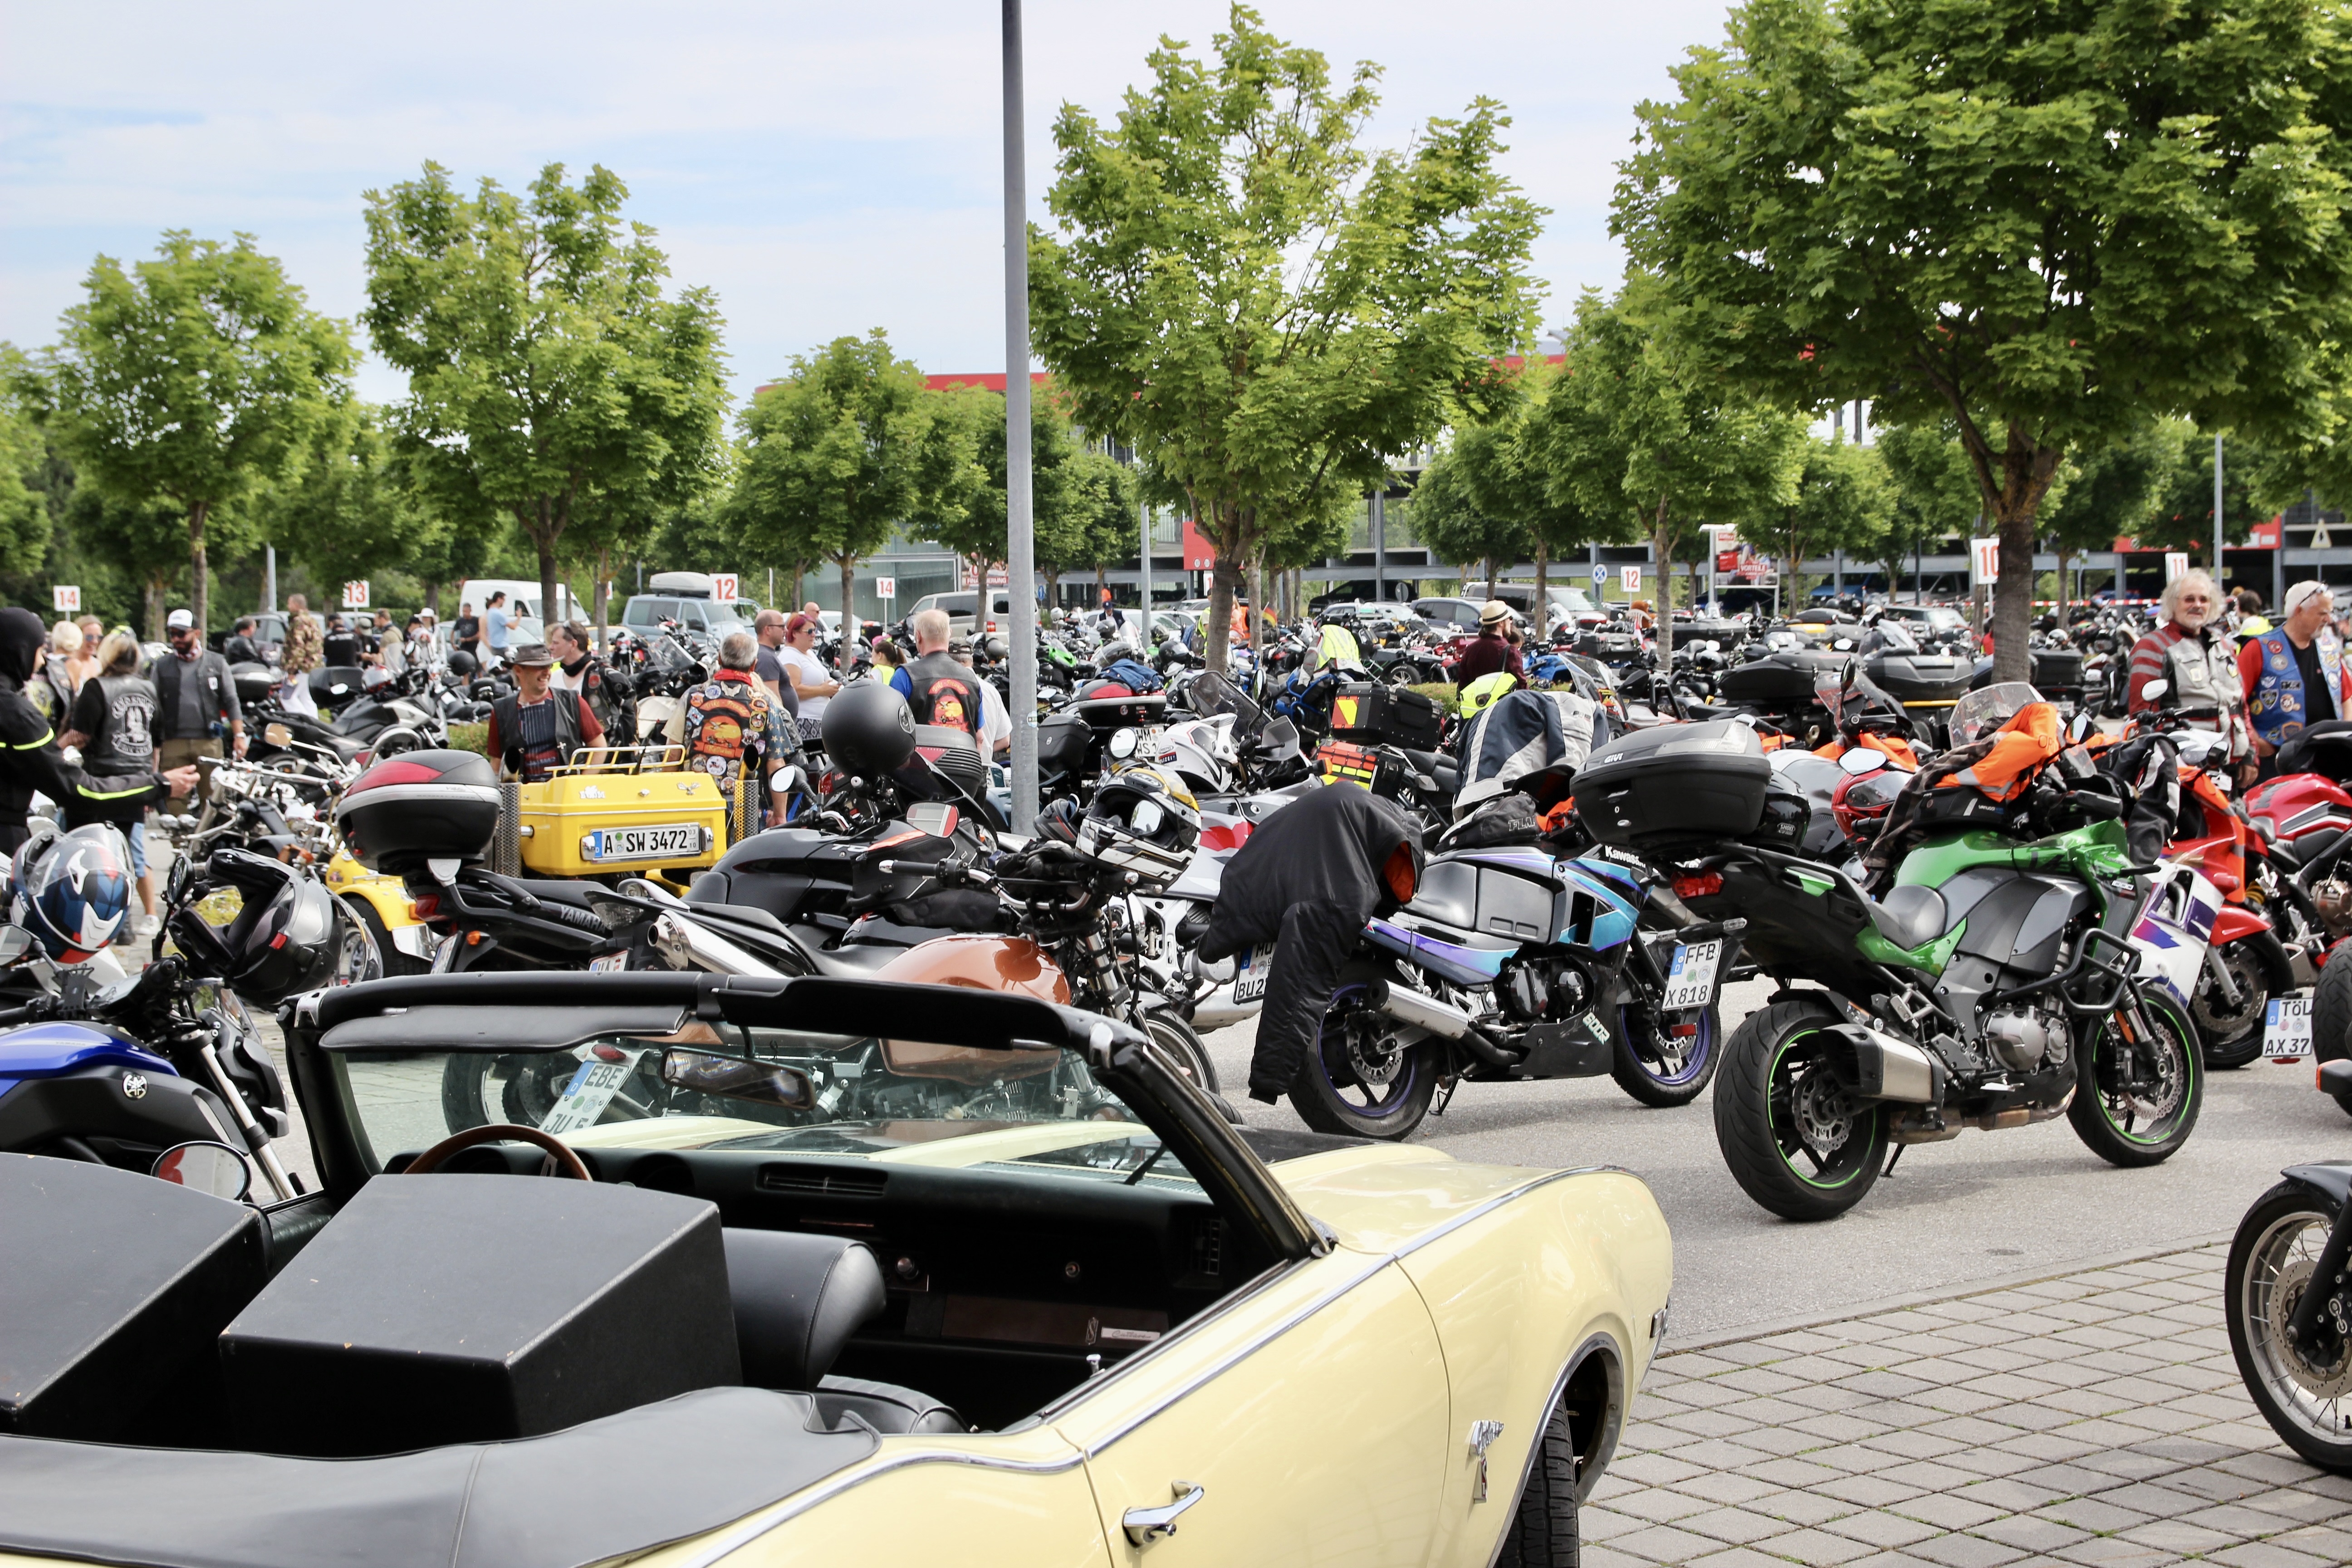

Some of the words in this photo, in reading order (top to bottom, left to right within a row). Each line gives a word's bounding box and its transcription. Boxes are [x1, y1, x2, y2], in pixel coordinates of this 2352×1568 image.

[880, 581, 893, 594] 14
[1626, 570, 1638, 588] 12
[348, 583, 365, 603] 13
[715, 578, 735, 599] 12
[59, 591, 76, 606] 14
[1136, 728, 1152, 742] WM
[1604, 753, 1623, 764] GIVI
[604, 835, 613, 854] A
[626, 833, 646, 853] SW
[650, 830, 687, 851] 3472
[560, 906, 606, 934] YAMAHA
[1686, 943, 1716, 964] FFB
[1675, 964, 1681, 972] D
[1665, 989, 1676, 1007] X
[1678, 985, 1708, 1004] 818
[2282, 1000, 2313, 1016] TÖL
[1582, 1012, 1610, 1045] 600R
[2269, 1015, 2276, 1024] D
[2265, 1039, 2286, 1054] AX
[2289, 1038, 2310, 1053] 37
[584, 1064, 624, 1089] EBE
[570, 1083, 578, 1092] D
[544, 1113, 573, 1134] JU
